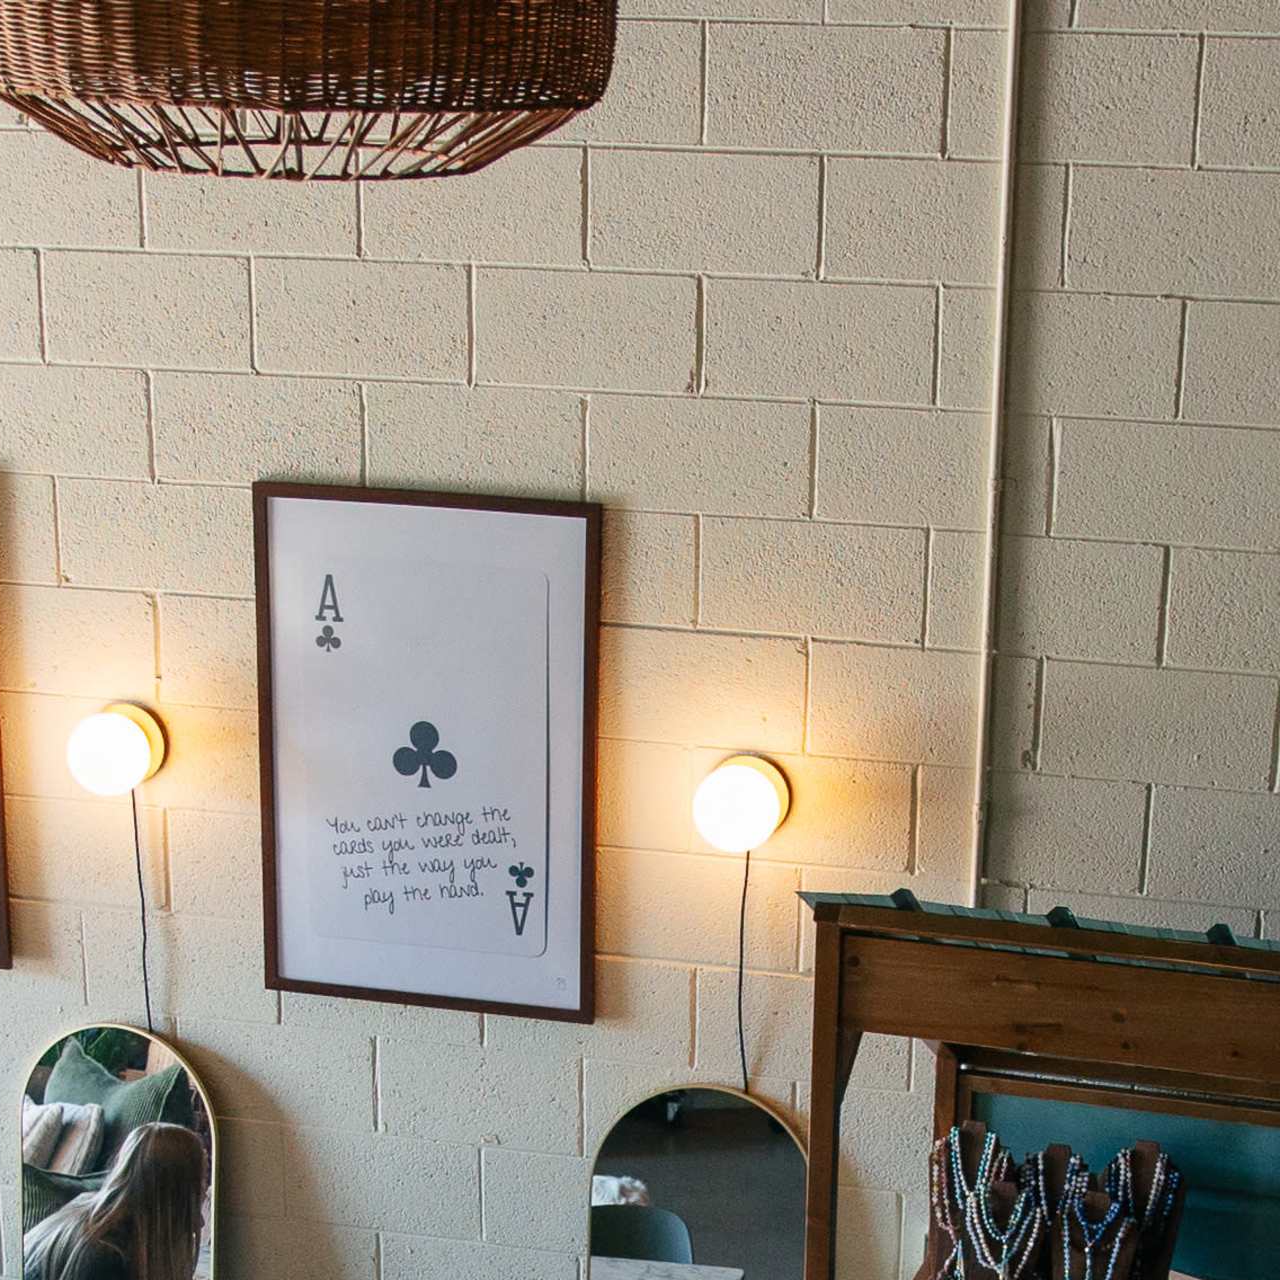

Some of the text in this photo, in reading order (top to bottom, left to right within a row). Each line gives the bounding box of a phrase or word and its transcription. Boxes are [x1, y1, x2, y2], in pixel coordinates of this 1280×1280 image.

[315, 573, 344, 622] A
[326, 806, 511, 836] You can't change the
[333, 826, 517, 863] cards you were dealt,
[342, 857, 497, 889] just the way you
[364, 882, 484, 914] play the hand.
[505, 890, 535, 936] A
